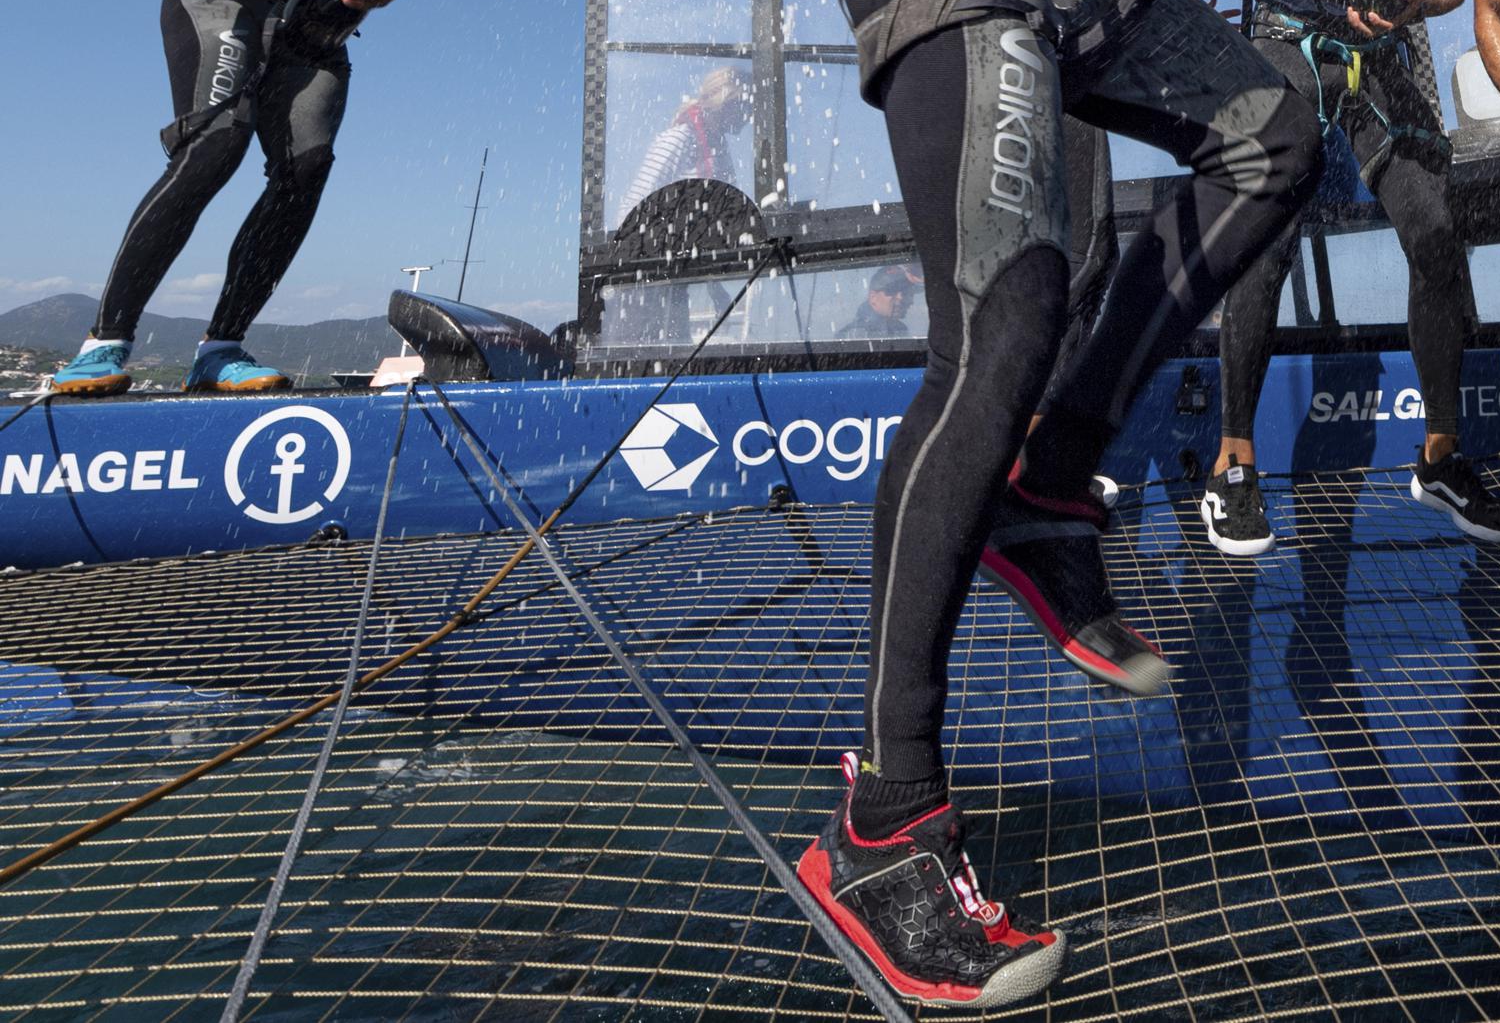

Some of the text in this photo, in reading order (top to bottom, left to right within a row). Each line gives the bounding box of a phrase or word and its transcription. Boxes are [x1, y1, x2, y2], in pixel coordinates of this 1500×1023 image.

[988, 29, 1045, 220] Vaikobi
[1309, 388, 1427, 423] SAILG
[0, 450, 199, 494] NAGEL
